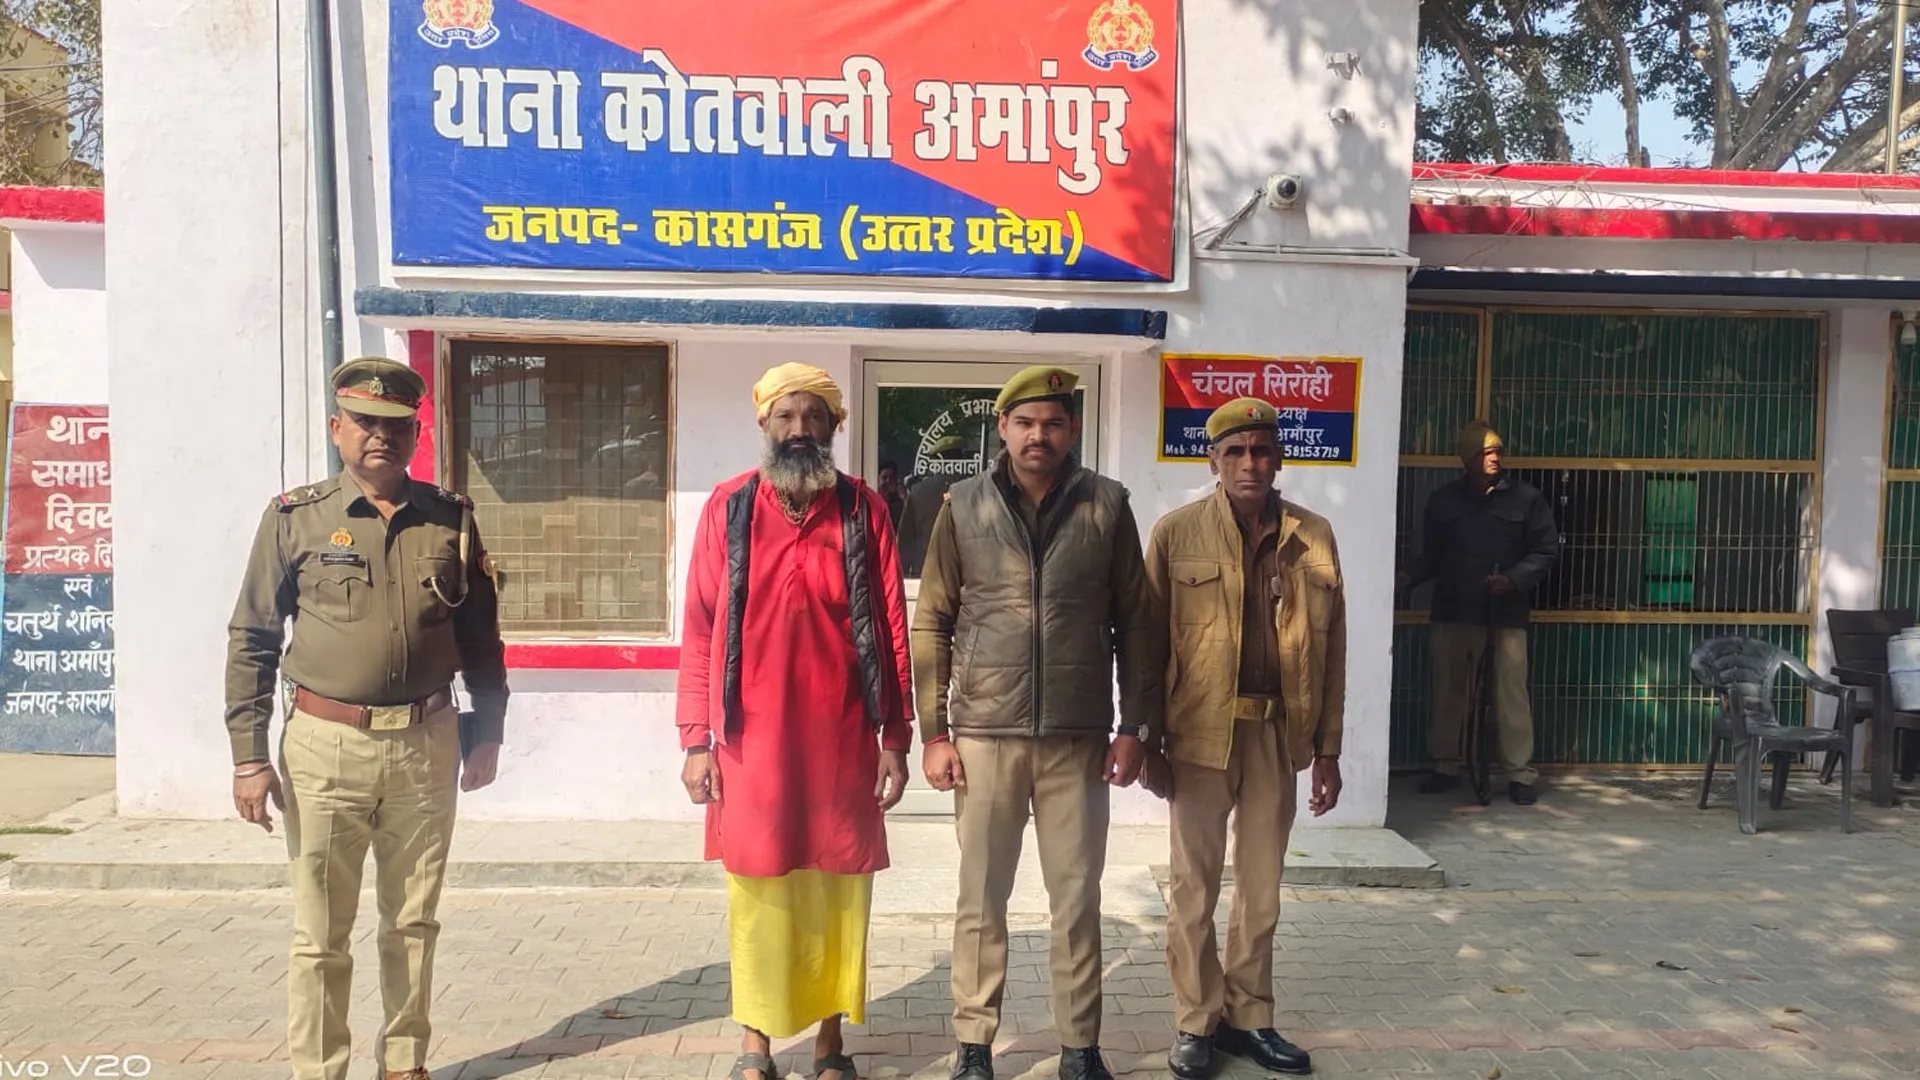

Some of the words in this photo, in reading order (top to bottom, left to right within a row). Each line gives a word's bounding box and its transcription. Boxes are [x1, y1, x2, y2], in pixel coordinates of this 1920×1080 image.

[433, 64, 583, 150] थाना
[600, 47, 893, 160] कोतवाली
[913, 59, 1132, 195] अमांपुर
[482, 204, 638, 246] जनपद-
[652, 202, 822, 250] कासगंज
[839, 204, 954, 261] (उत्तर
[965, 207, 1084, 266] प्रदेश)
[1191, 365, 1256, 398] चंचल
[1263, 362, 1333, 402] सिरोही
[928, 453, 982, 475] कोतवाली
[12, 648, 57, 675] थाना
